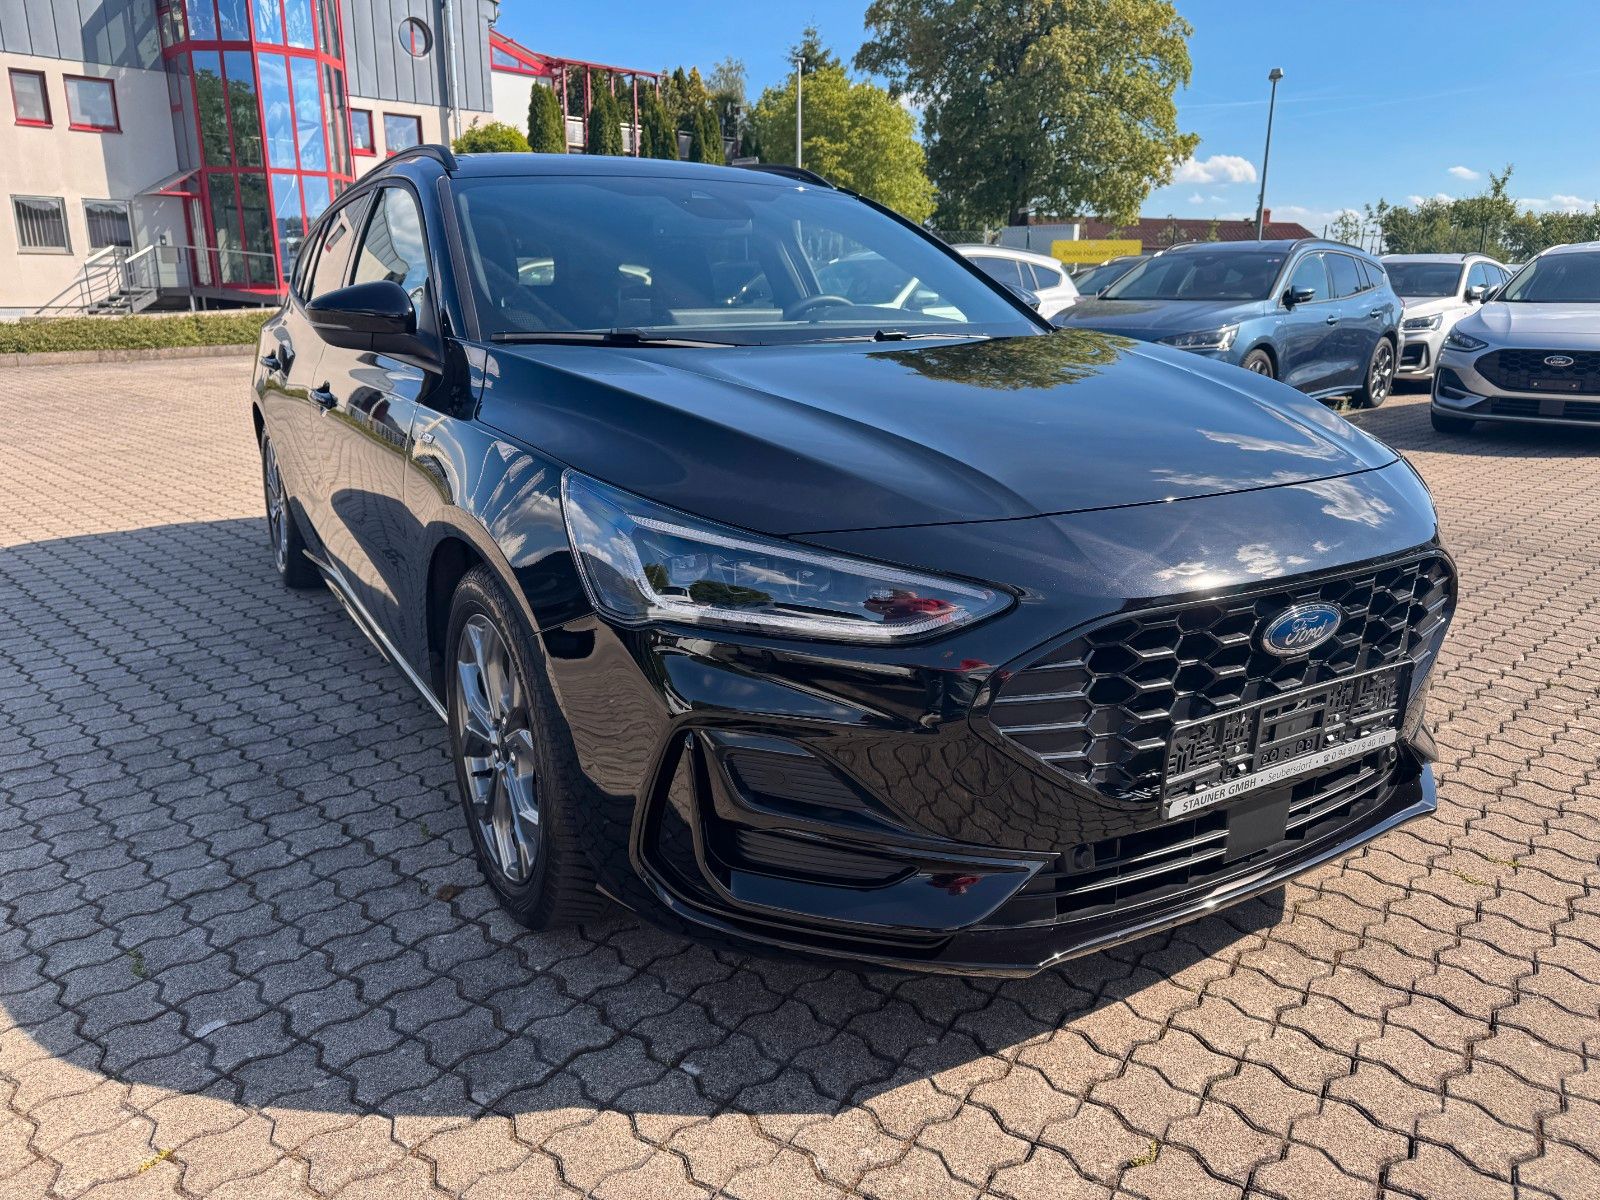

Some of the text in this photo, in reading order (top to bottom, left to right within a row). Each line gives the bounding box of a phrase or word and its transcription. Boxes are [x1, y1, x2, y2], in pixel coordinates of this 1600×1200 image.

[1285, 616, 1328, 646] Ford
[1182, 788, 1226, 812] STAUNER
[1228, 777, 1256, 795] GMBH
[1268, 758, 1312, 781] Seubersdorf
